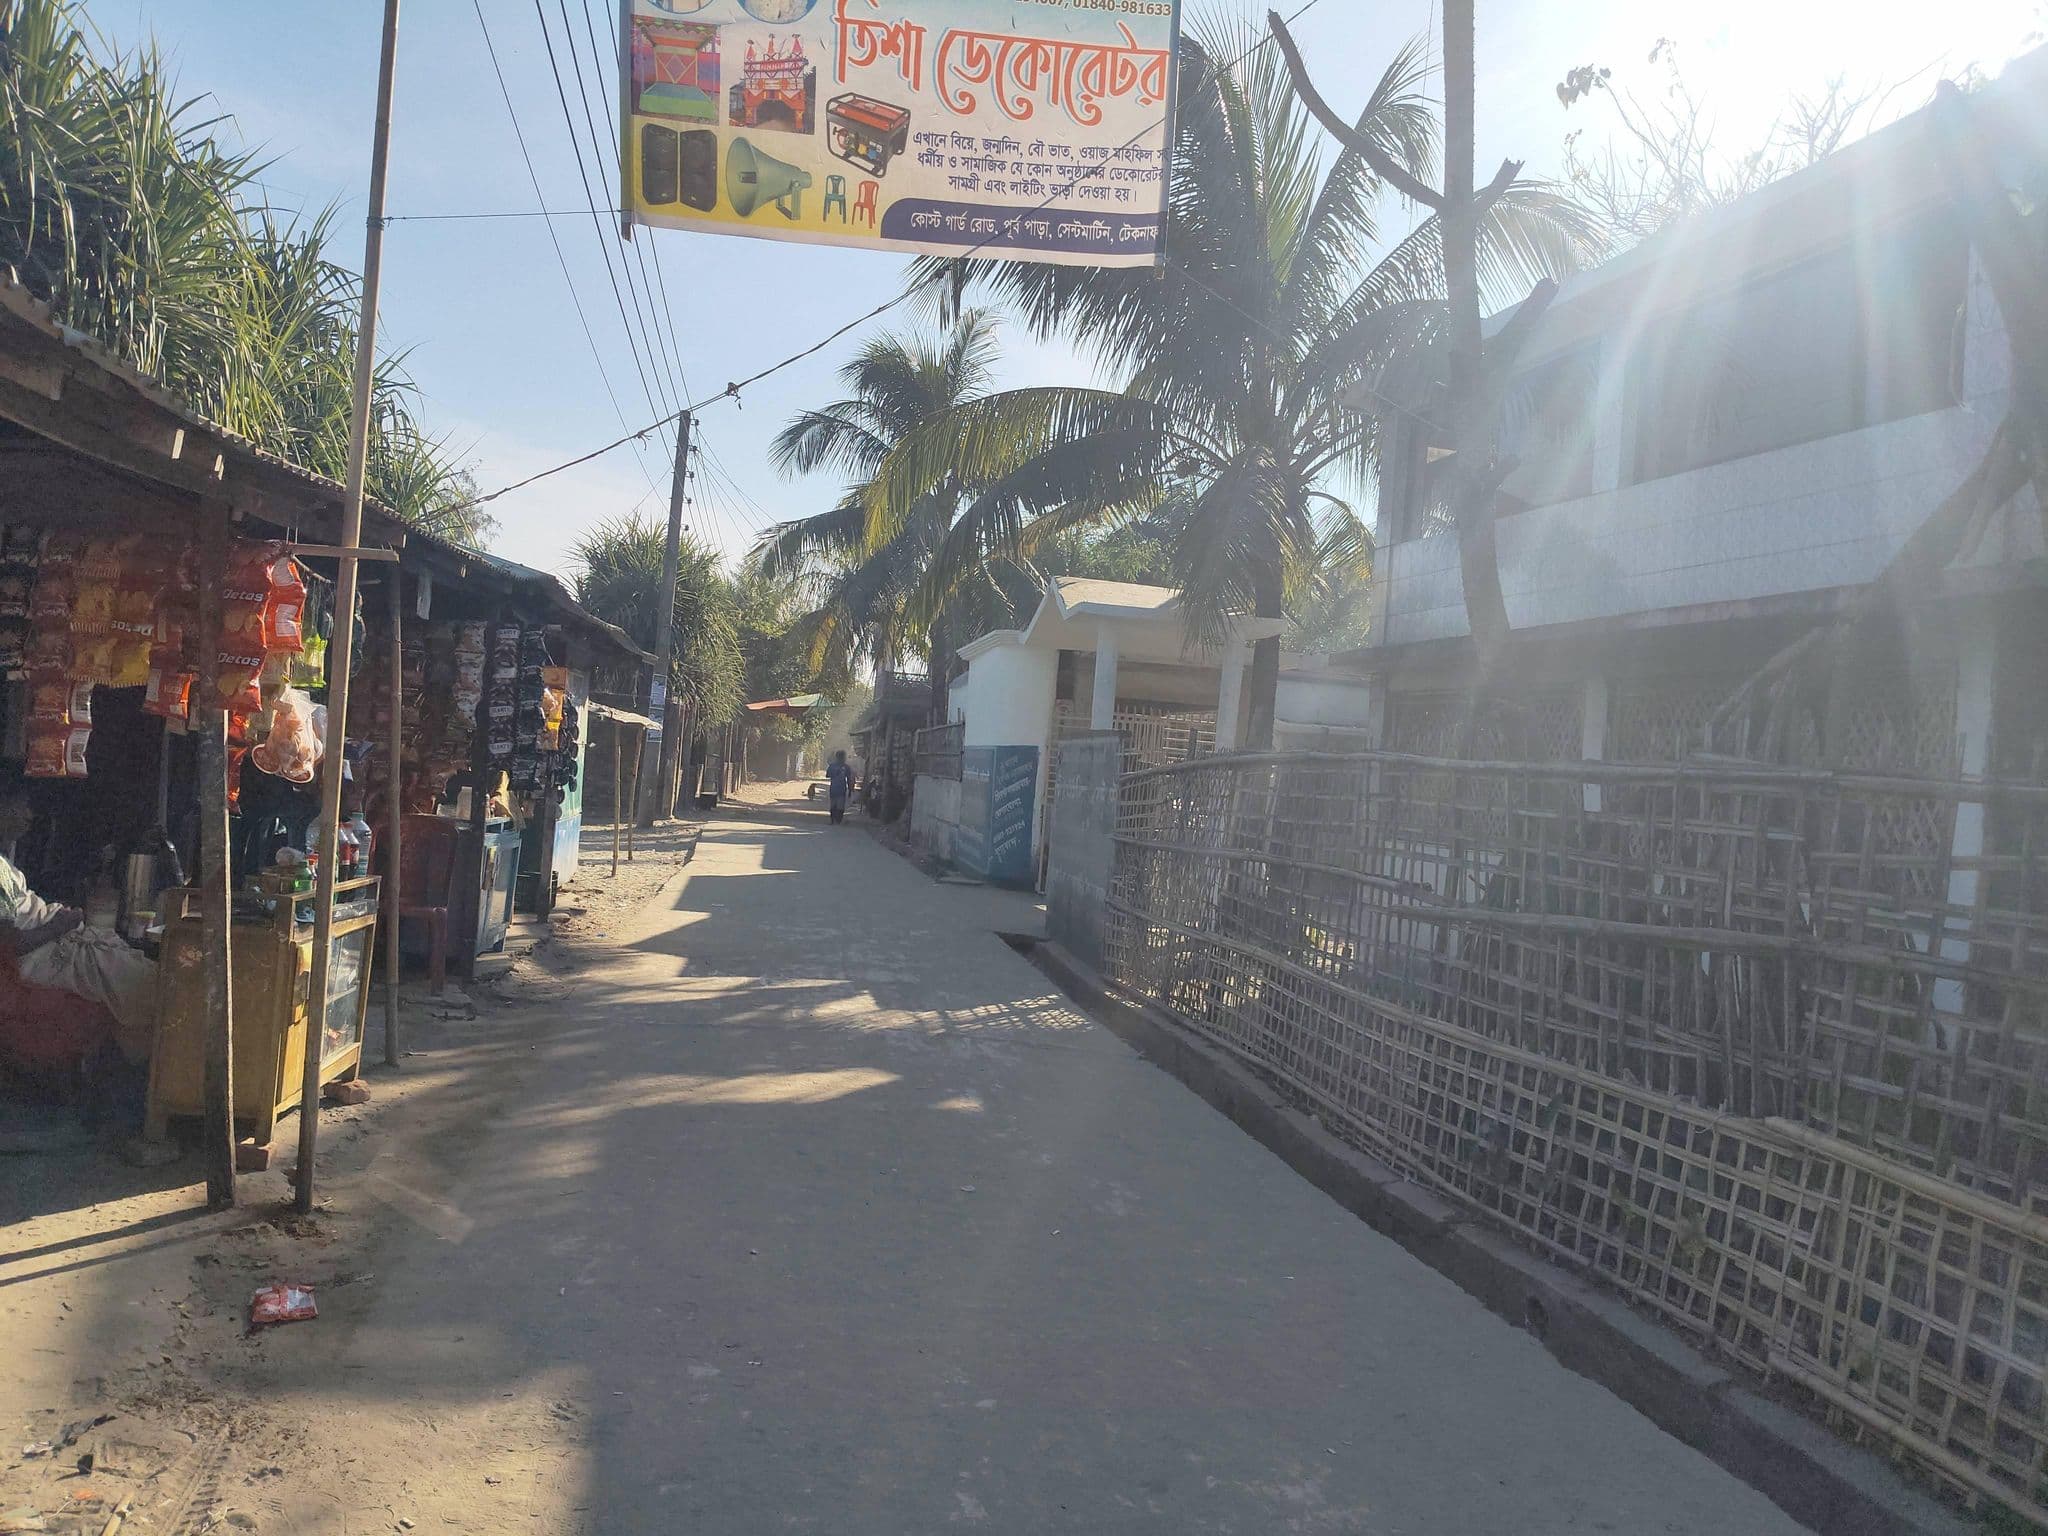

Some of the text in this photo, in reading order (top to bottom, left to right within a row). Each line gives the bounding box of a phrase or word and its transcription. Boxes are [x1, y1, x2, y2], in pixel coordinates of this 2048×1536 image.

[834, 0, 1170, 126] তিশা ডেকোরেটর
[913, 131, 948, 148] এখানে
[951, 131, 978, 154] বিয়ে,
[982, 136, 1023, 158] জন্মদিন,
[1029, 139, 1045, 157] বৌ
[1048, 144, 1073, 162] ভাত,
[1080, 145, 1110, 160] ওয়াজ
[1113, 144, 1154, 163] মাহফিল
[917, 148, 945, 168] ধর্মীয়
[948, 156, 957, 168] ও
[961, 155, 1007, 173] সামাজিক
[1011, 161, 1024, 175] যে
[1027, 162, 1053, 177] কোন
[1056, 160, 1105, 180] অনুষ্ঠানের
[948, 172, 980, 192] সামগ্রী
[984, 179, 1006, 195] এবং
[1010, 178, 1047, 197] লাইটিং
[1049, 183, 1074, 200] ভাড়া
[1079, 185, 1111, 200] দেওয়া
[911, 210, 942, 229] কোস্ট
[945, 211, 968, 231] গার্ড
[1003, 214, 1022, 240] পূর্ব
[1025, 218, 1052, 240] পাড়া,
[1057, 219, 1113, 244] সেন্টমার্টিন,
[1119, 219, 1159, 241] টেকনাফ
